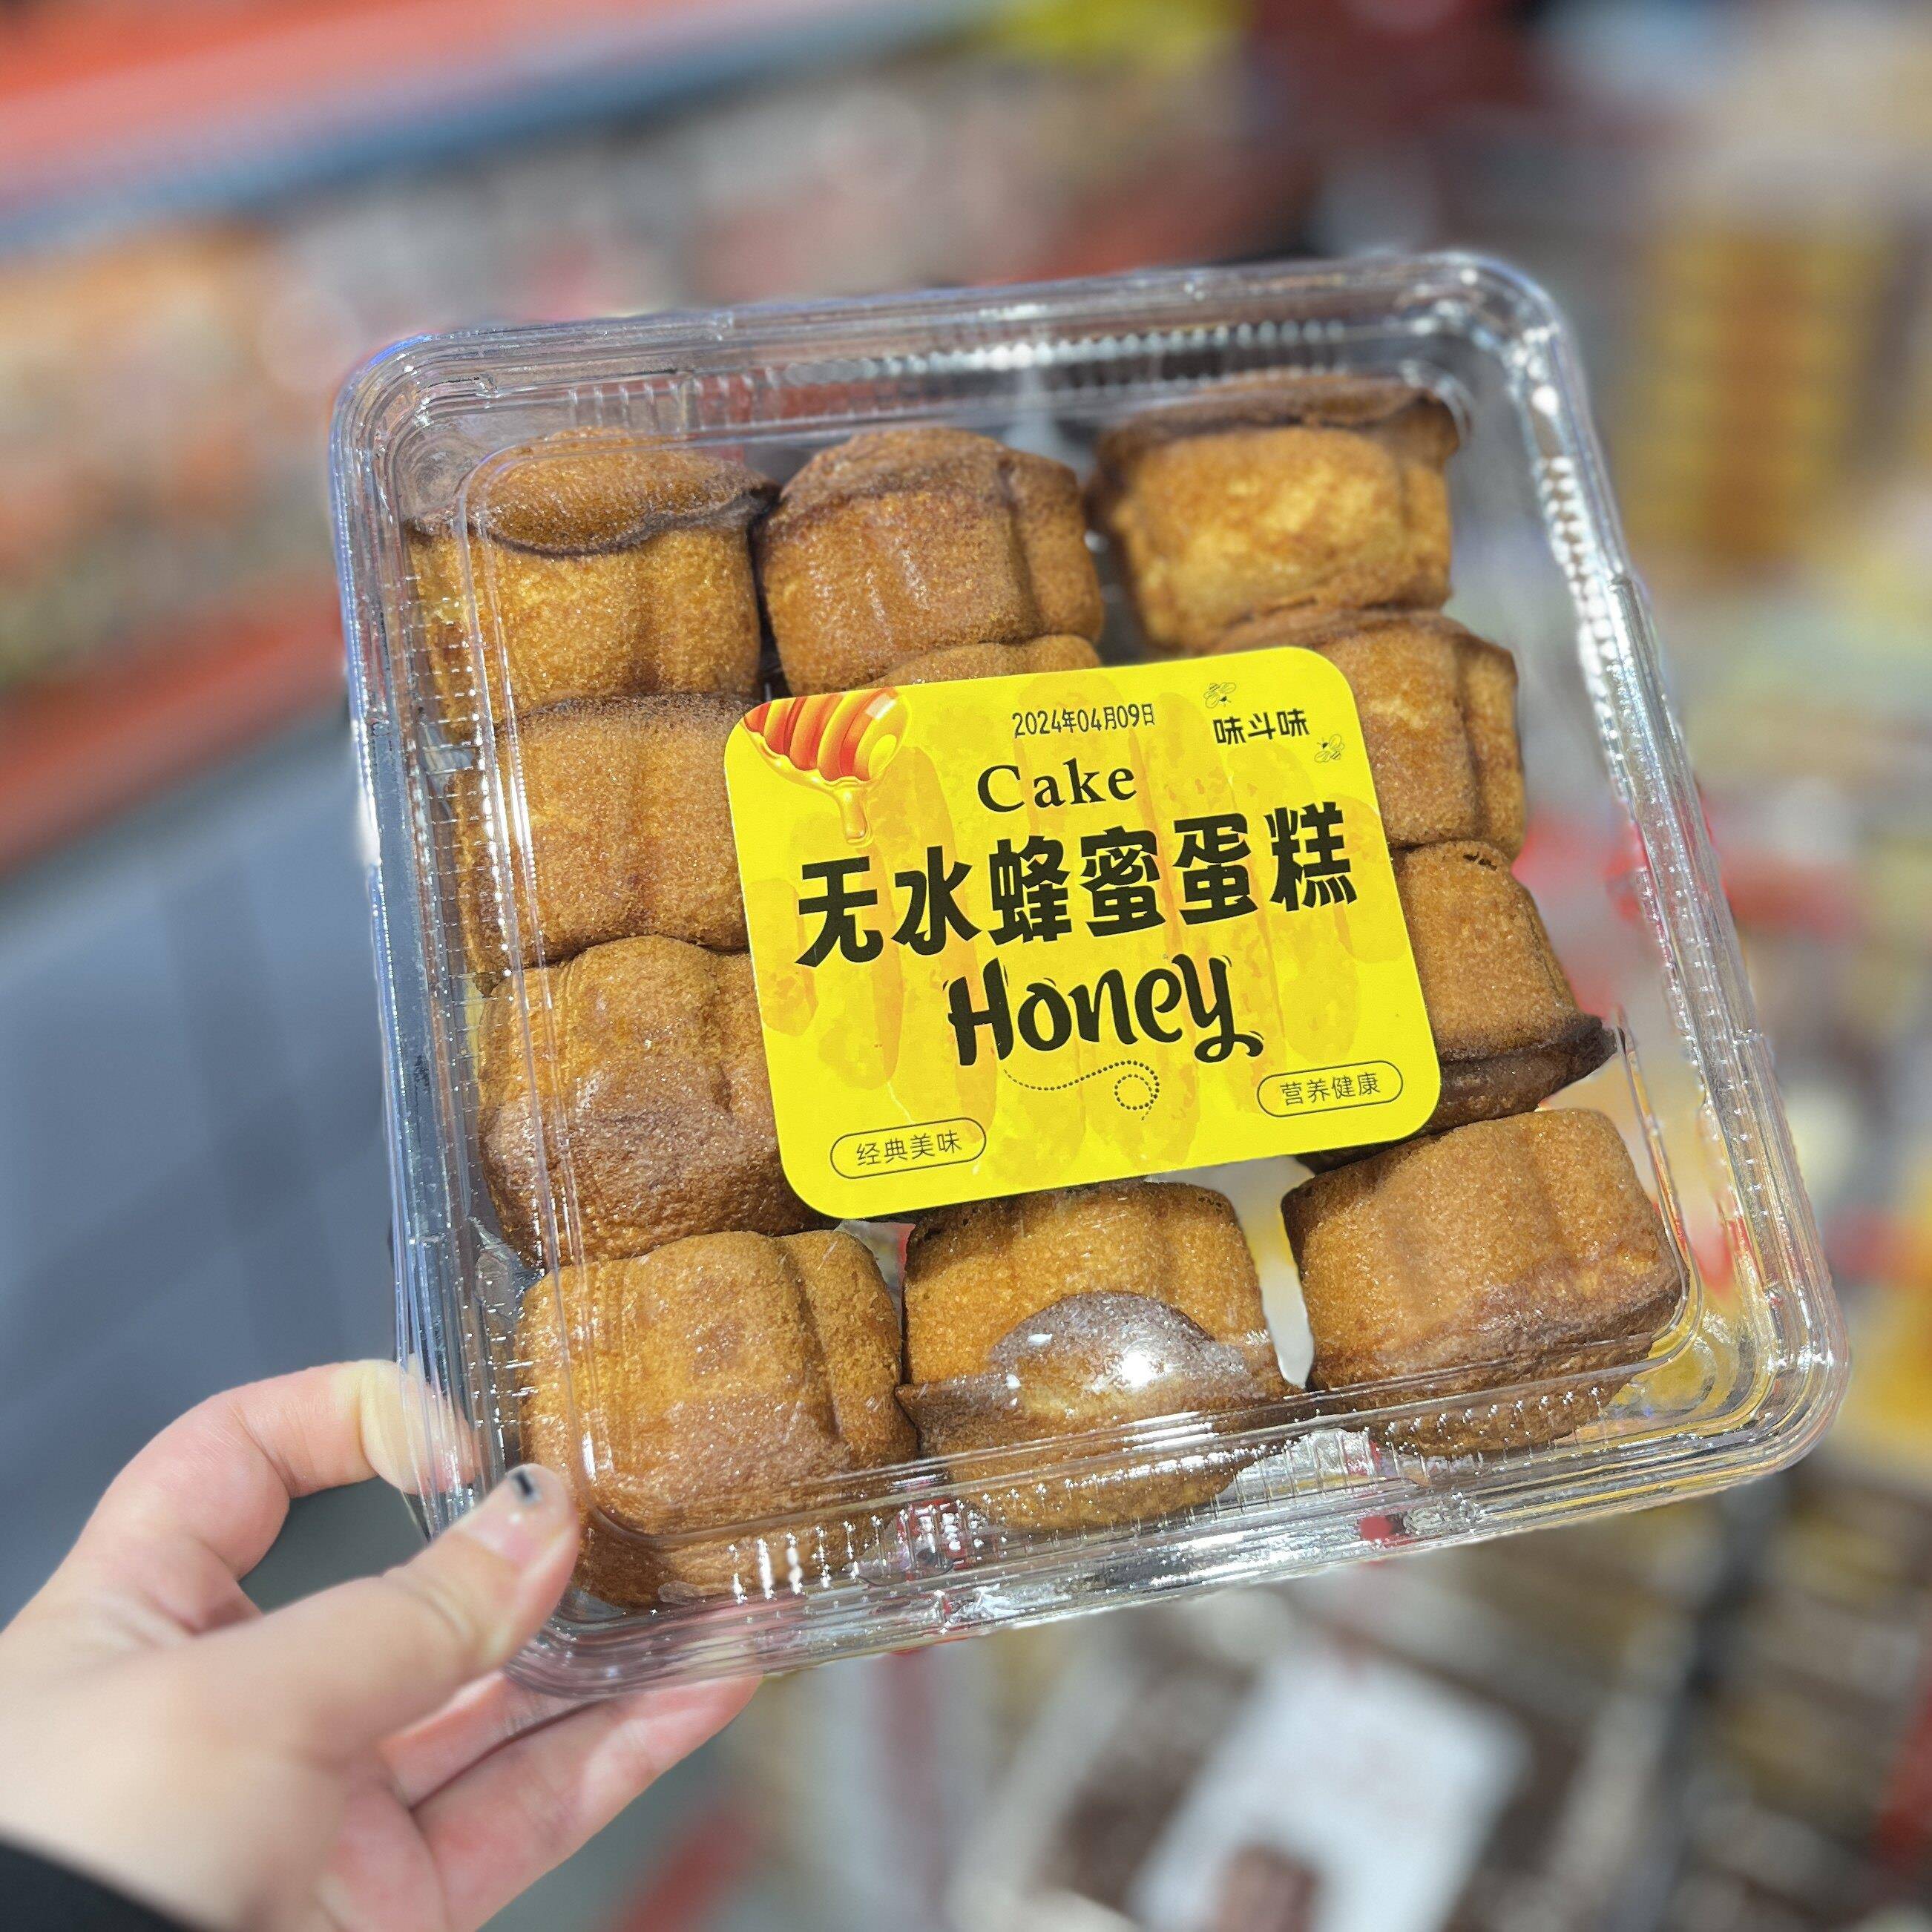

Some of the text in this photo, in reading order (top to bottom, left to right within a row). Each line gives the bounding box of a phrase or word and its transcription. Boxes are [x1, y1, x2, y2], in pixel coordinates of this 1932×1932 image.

[1011, 703, 1155, 739] 2024年04月09日
[1212, 709, 1310, 745] 味斗味
[977, 758, 1137, 812] Cake
[795, 801, 1358, 967] 无水蜂蜜蛋糕
[946, 954, 1264, 1066] Honey
[1279, 1071, 1381, 1106] 营养健康
[855, 1129, 963, 1166] 经典美味
